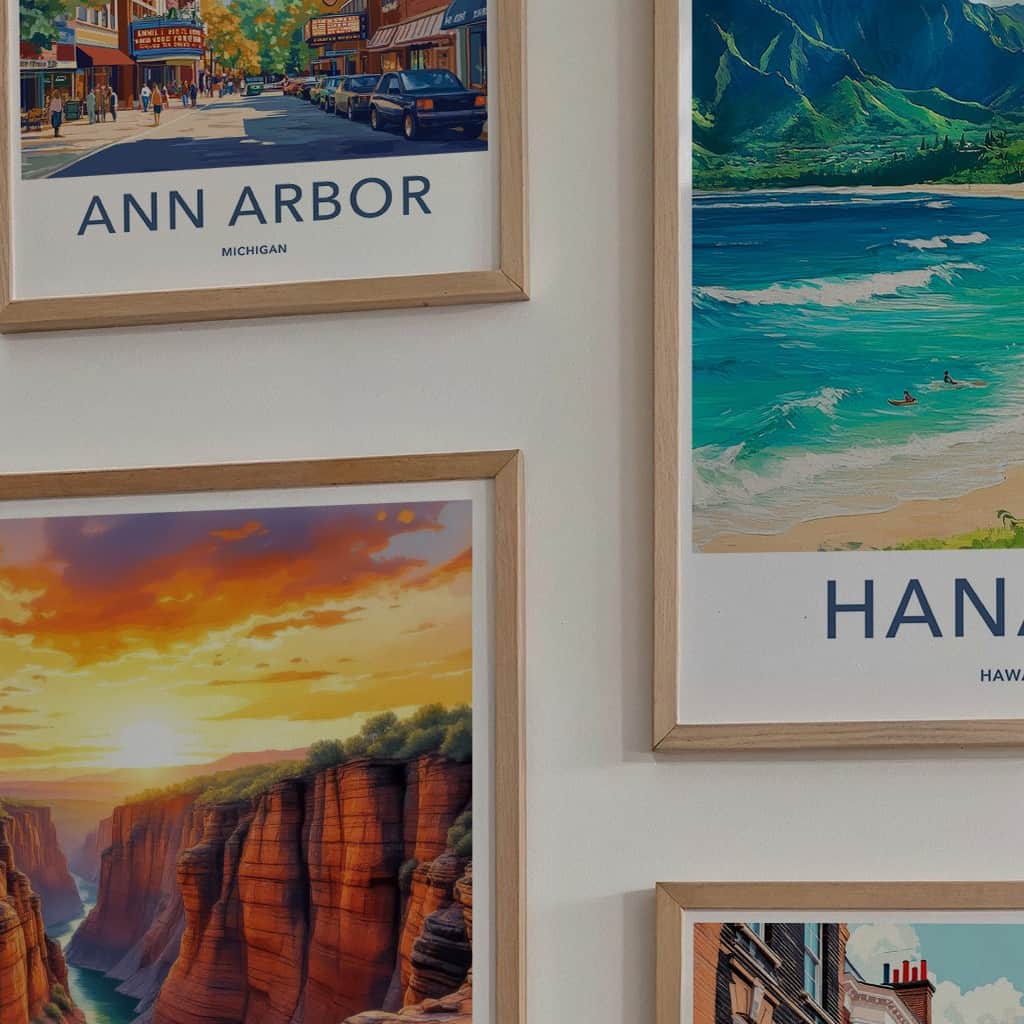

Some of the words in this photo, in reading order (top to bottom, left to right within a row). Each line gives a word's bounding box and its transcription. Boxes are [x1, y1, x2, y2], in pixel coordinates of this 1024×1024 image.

[79, 189, 204, 236] ANN
[229, 175, 432, 227] ARBOR
[221, 244, 287, 257] MICHIGAN
[826, 577, 1024, 639] HAN
[980, 669, 1024, 682] HAW
